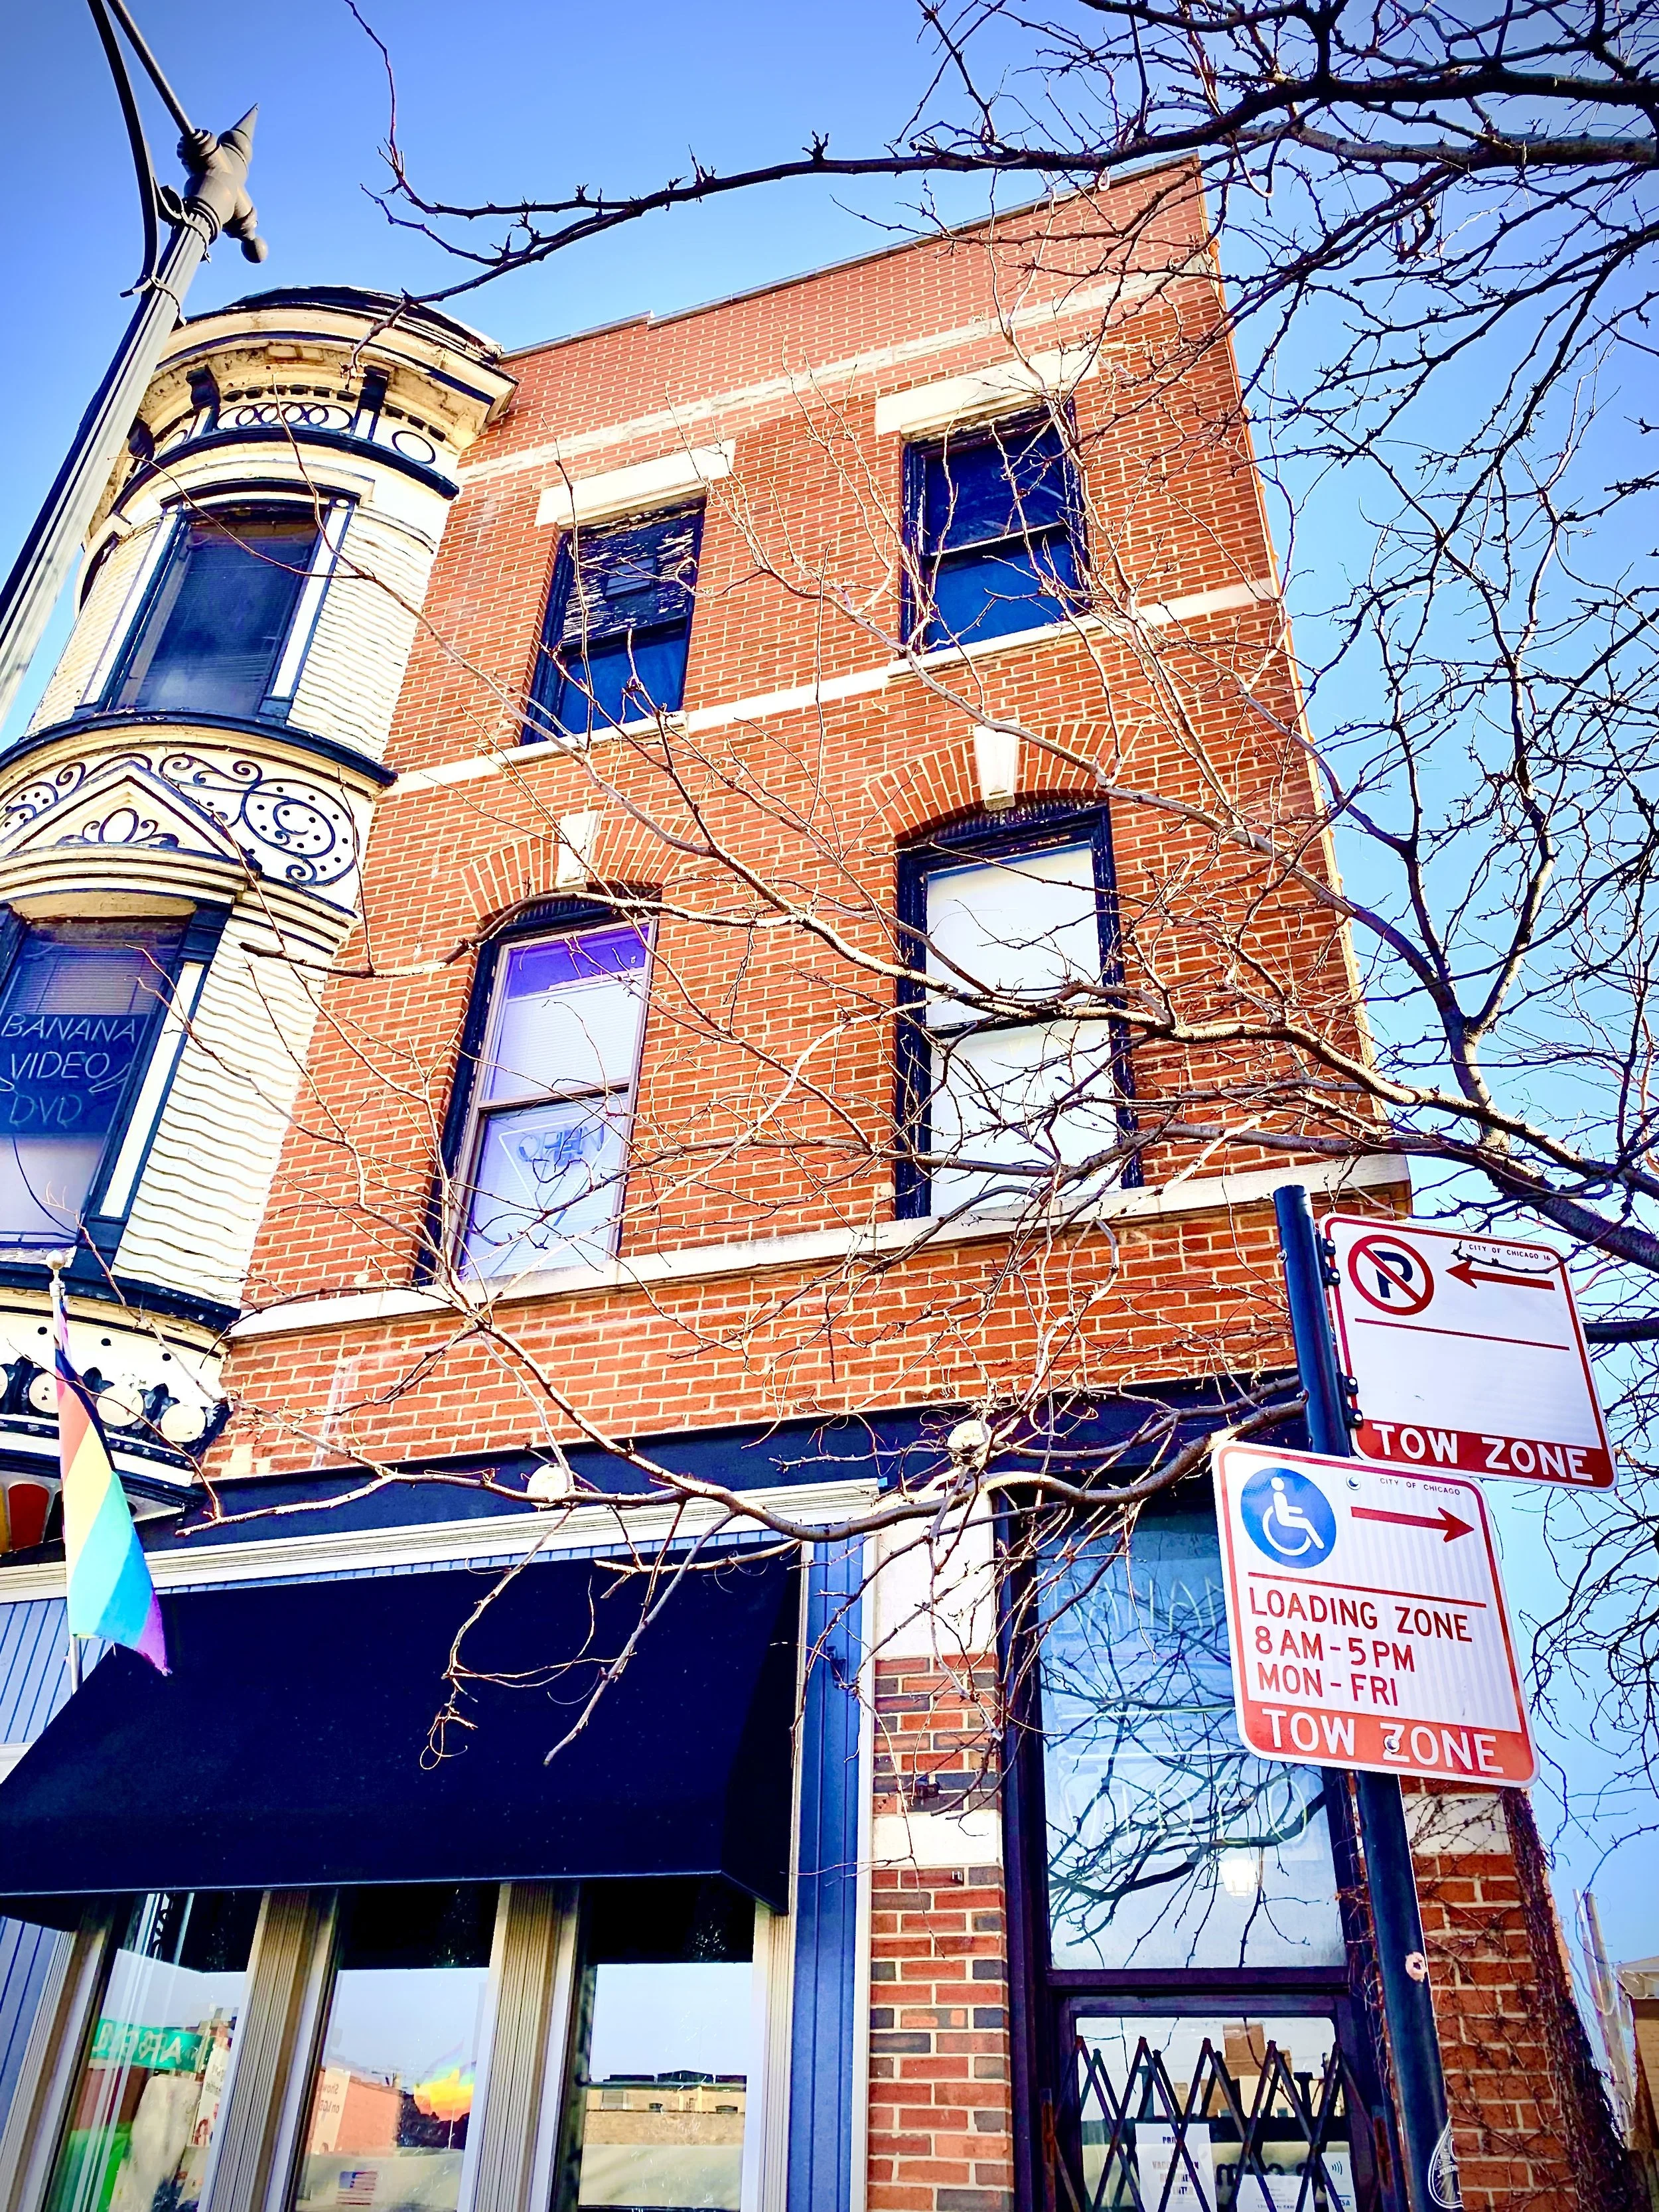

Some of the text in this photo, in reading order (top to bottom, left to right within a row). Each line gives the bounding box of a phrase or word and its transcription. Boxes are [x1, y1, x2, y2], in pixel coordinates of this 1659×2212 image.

[1, 1013, 135, 1043] BANANA
[12, 1051, 109, 1080] VIDEO
[9, 1095, 82, 1127] DVD
[517, 1125, 605, 1163] OPEN
[1506, 1250, 1539, 1259] CHICAGO
[1372, 1423, 1593, 1481] TOW ZONE
[1423, 1484, 1460, 1495] CHICAGO
[1250, 1587, 1473, 1643] LOADING ZONE
[1262, 1708, 1503, 1773] TOW ZONE
